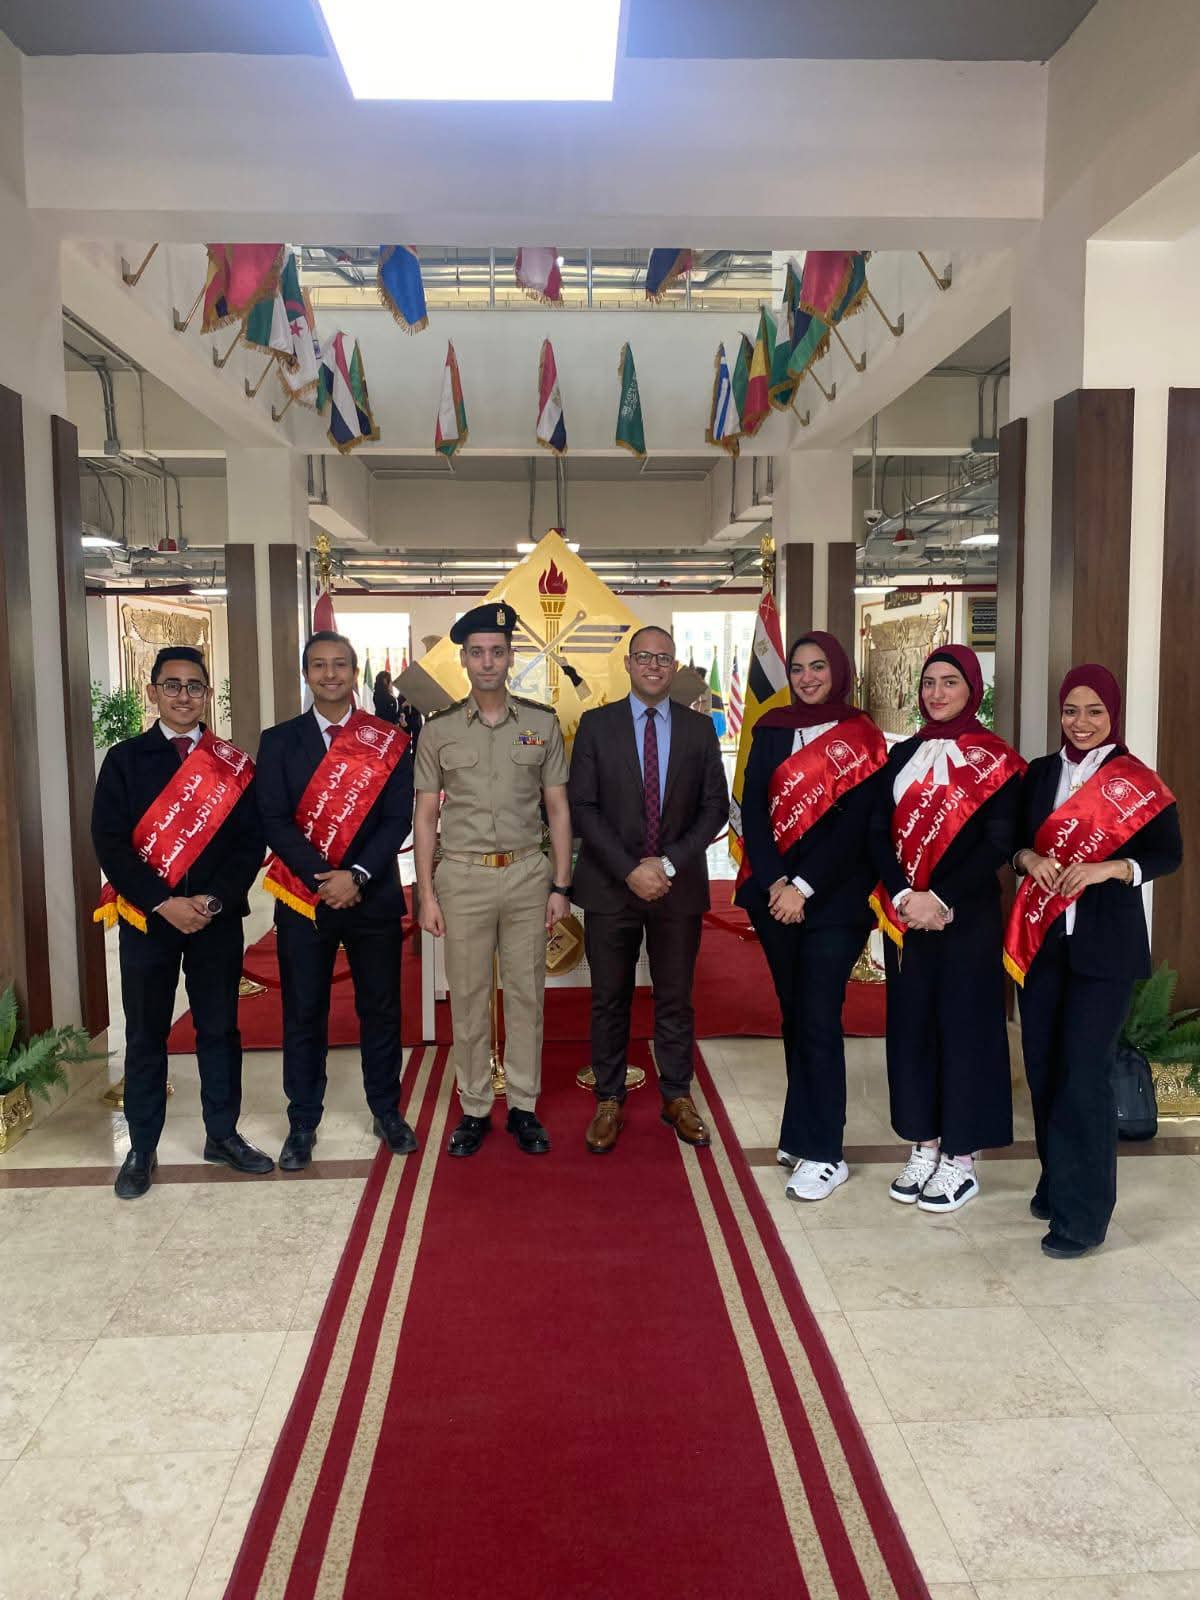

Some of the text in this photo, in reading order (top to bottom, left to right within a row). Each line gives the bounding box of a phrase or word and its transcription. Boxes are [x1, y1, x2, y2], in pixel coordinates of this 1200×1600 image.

[182, 774, 203, 801] طلاب
[329, 762, 348, 790] طلاب
[781, 771, 805, 797] طلاب
[307, 791, 333, 819] جامعة
[331, 787, 361, 823] التربية
[776, 783, 826, 832] إدارة التربية
[919, 781, 940, 808] لاب
[942, 786, 969, 810] إدارة
[152, 801, 185, 831] جامعة
[179, 803, 213, 838] التربية
[898, 808, 925, 838] جامعة
[920, 808, 947, 845] التربية
[1055, 818, 1079, 847] طلاب
[1080, 828, 1109, 854] إدارة
